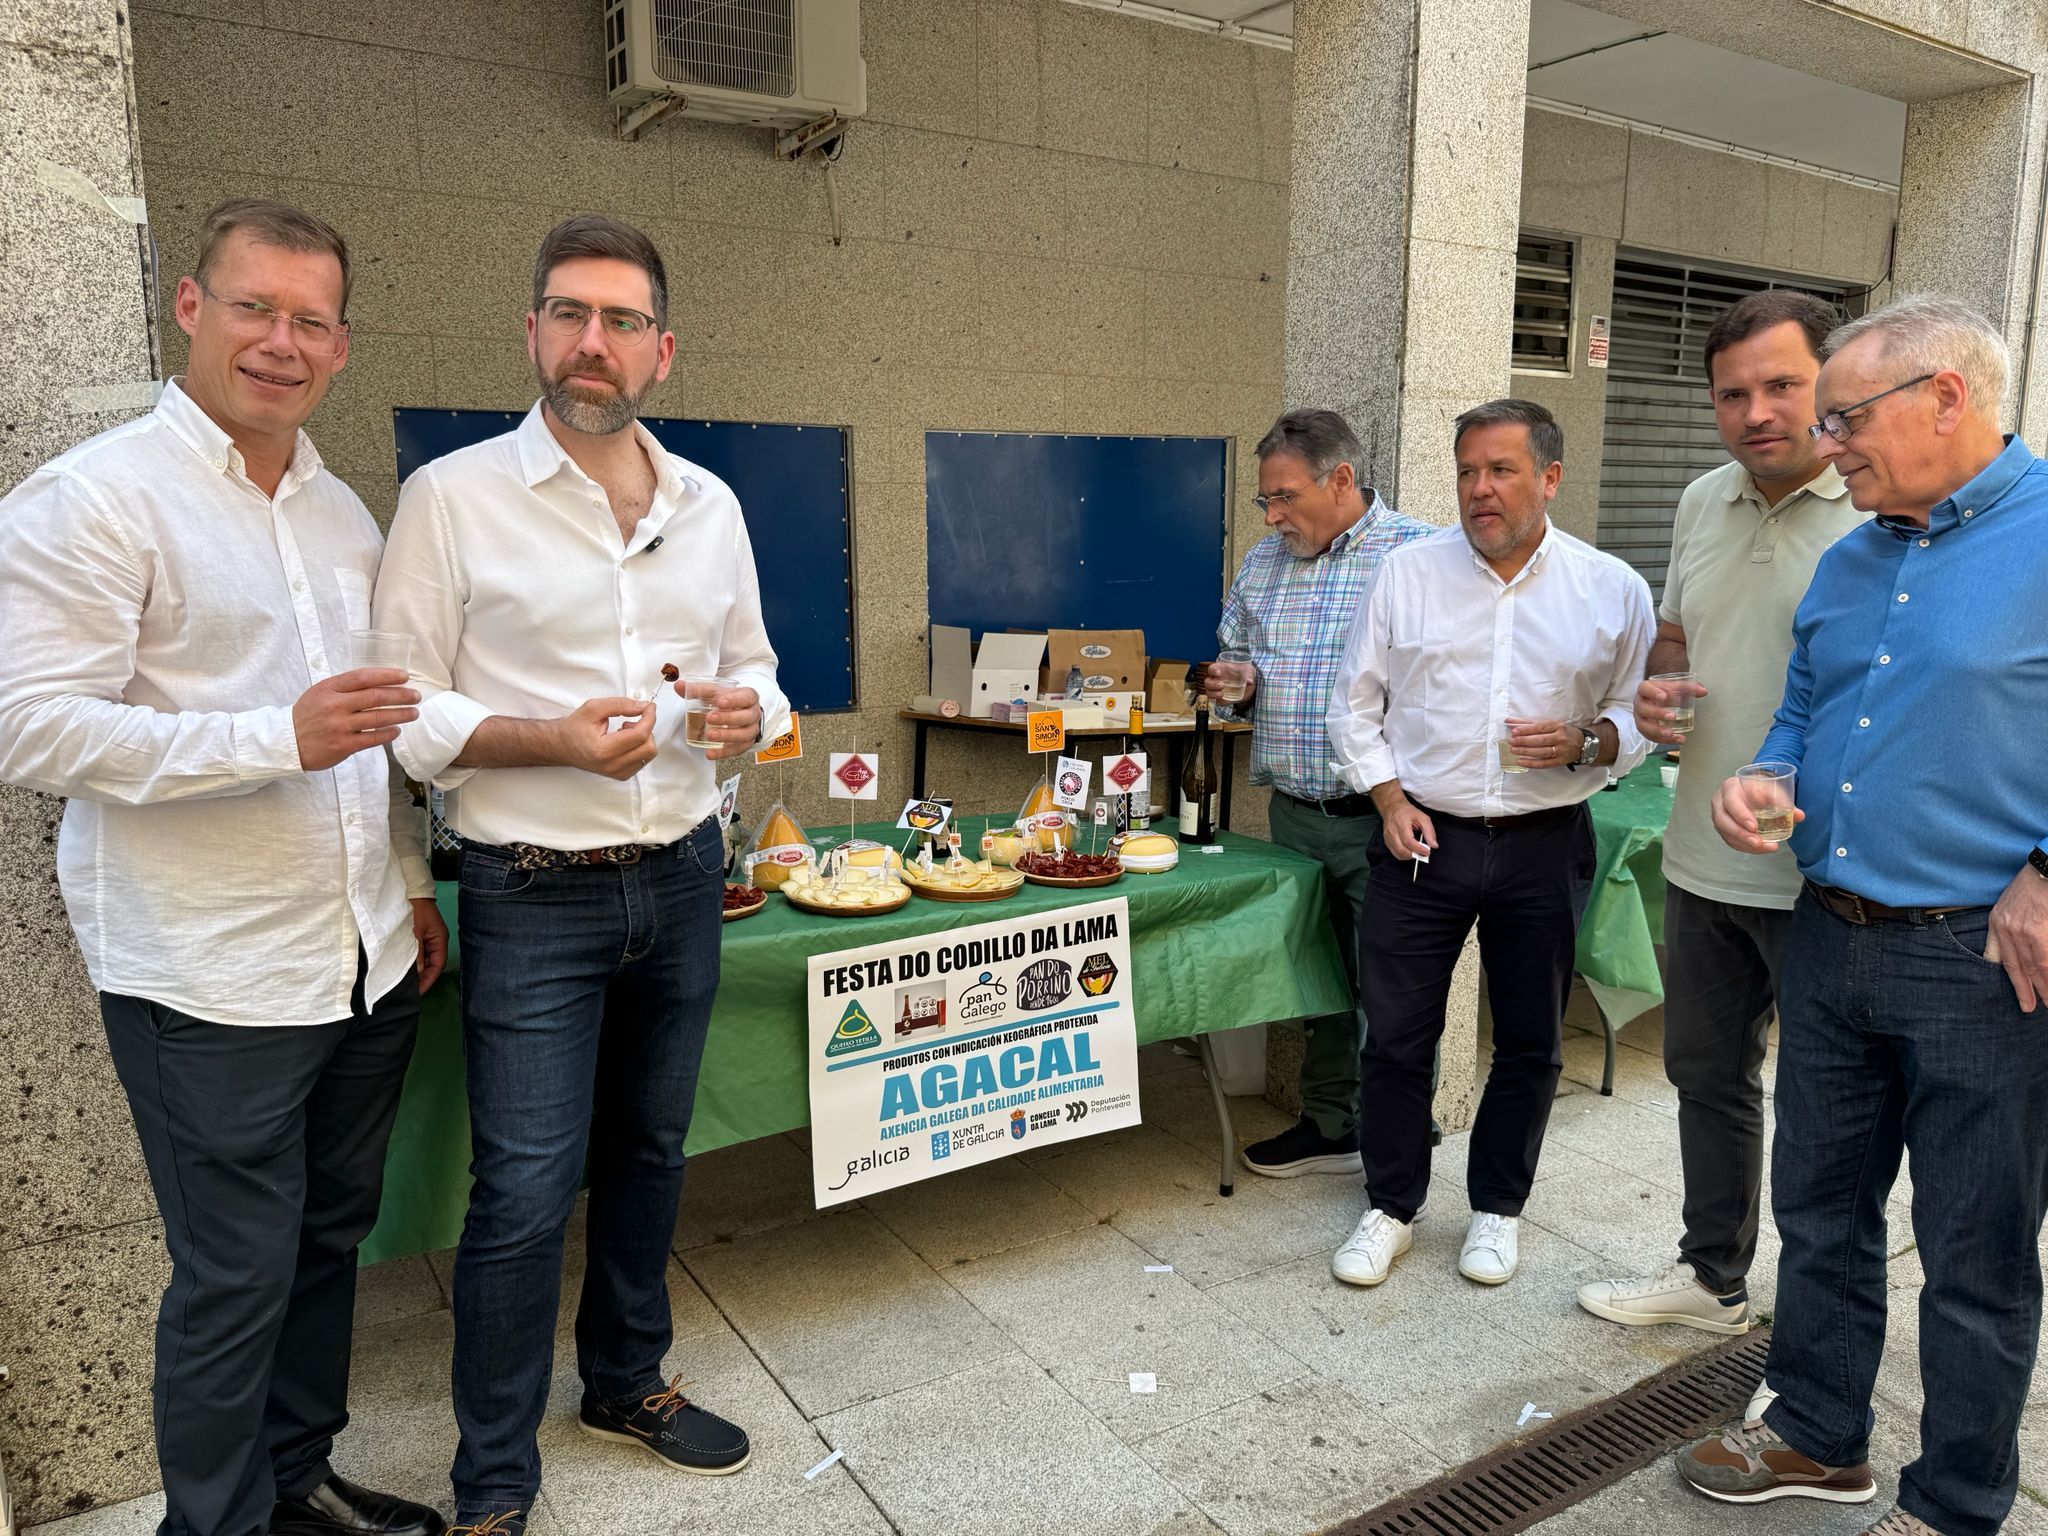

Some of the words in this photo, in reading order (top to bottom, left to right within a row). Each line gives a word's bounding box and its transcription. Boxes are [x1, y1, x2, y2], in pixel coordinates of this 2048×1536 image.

[1035, 725, 1050, 733] SAN
[823, 958, 893, 997] FESTA
[898, 950, 931, 981] DO
[937, 932, 1026, 974] CODILLO
[1031, 925, 1059, 954] DA
[1063, 914, 1119, 947] LAMA
[1088, 955, 1109, 965] MEL
[1029, 960, 1045, 979] PAN
[1047, 959, 1060, 977] DO
[966, 992, 992, 1009] pan
[960, 1001, 1007, 1019] Galego
[830, 1040, 855, 1051] QUEIXO
[855, 1035, 878, 1045] TETILLA
[883, 1052, 931, 1072] PRODUTOS
[932, 1046, 951, 1061] CON
[952, 1034, 1002, 1057] INDICACIÓN
[1003, 1023, 1053, 1043] XEOGRÁFICA
[1054, 1014, 1099, 1033] PROTEXIDA
[879, 1032, 1101, 1122] AGACAL
[880, 1117, 927, 1141] AXENCIA
[929, 1107, 969, 1128] GALEGA
[971, 1103, 986, 1116] DA
[987, 1089, 1037, 1112] CALIDADE
[1038, 1074, 1105, 1100] ALIMENTARIA
[1090, 1092, 1131, 1108] Deputación
[1091, 1100, 1131, 1114] Pontevedra
[1030, 1108, 1061, 1123] CONCELLO
[952, 1123, 985, 1140] XUNTA
[1030, 1121, 1040, 1132] DA
[1040, 1118, 1057, 1130] LAMA
[952, 1138, 965, 1151] DE
[966, 1128, 1005, 1148] GALICIA
[828, 1146, 910, 1191] galicia
